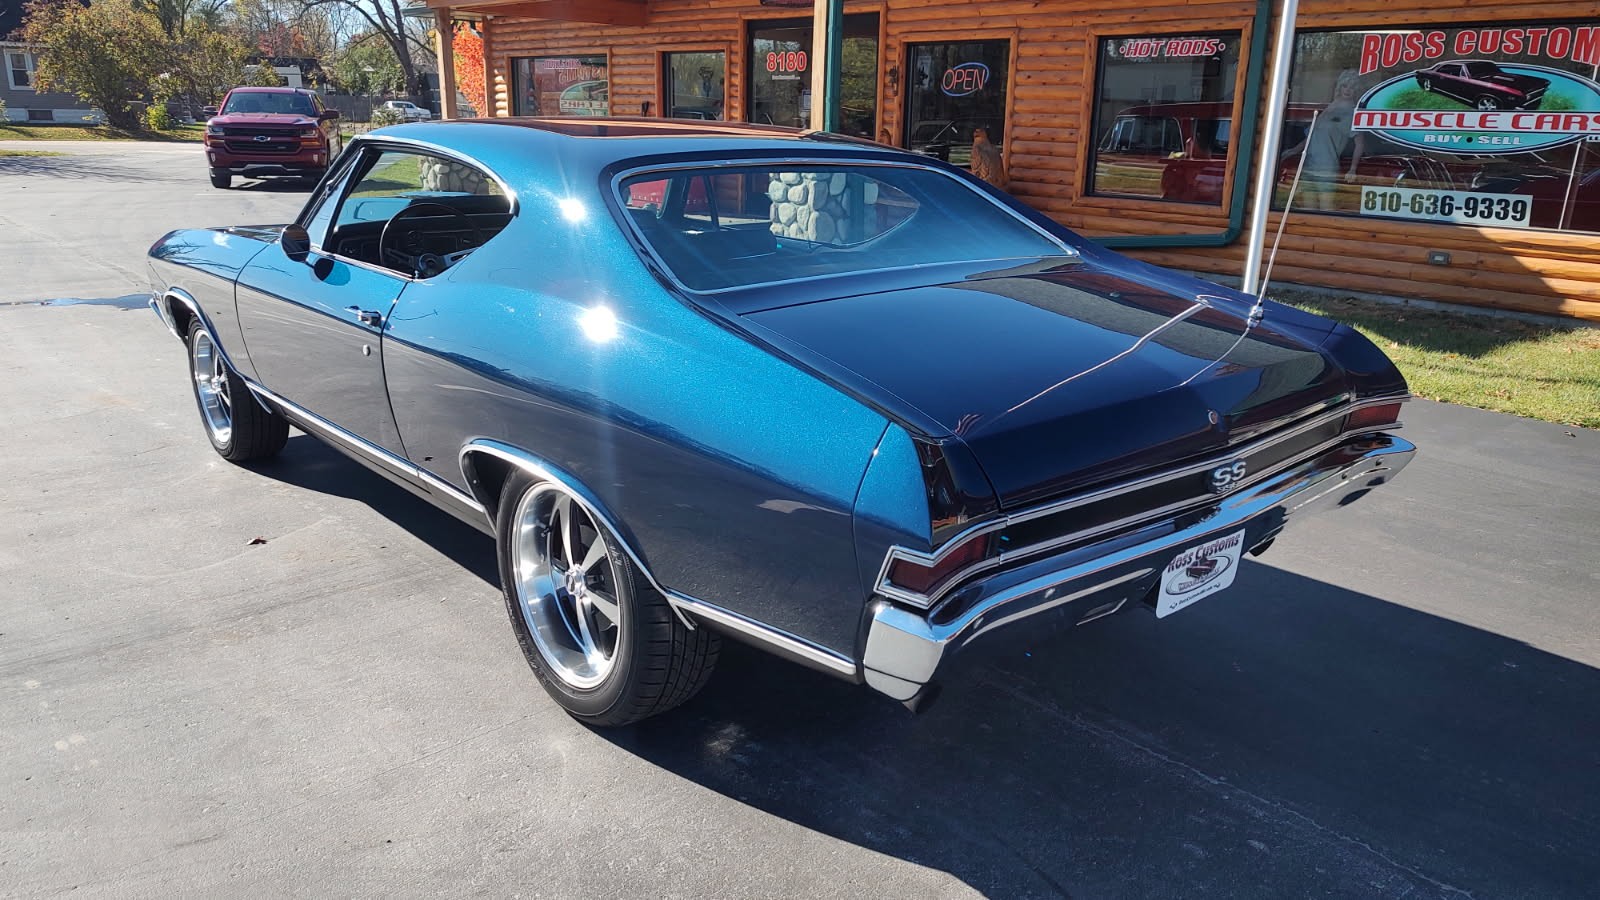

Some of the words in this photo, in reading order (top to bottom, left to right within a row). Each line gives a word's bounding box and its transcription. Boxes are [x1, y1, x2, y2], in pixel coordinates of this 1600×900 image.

[1125, 39, 1165, 57] HOT
[1164, 39, 1219, 57] RODS
[1359, 31, 1446, 75] ROSS
[767, 51, 807, 71] 8180
[943, 69, 985, 90] OPEN
[1353, 112, 1500, 129] MUSCLE
[1424, 134, 1463, 143] BUY
[1478, 135, 1523, 145] SELL
[1364, 190, 1527, 222] 810-636-9339
[1212, 461, 1247, 486] SS
